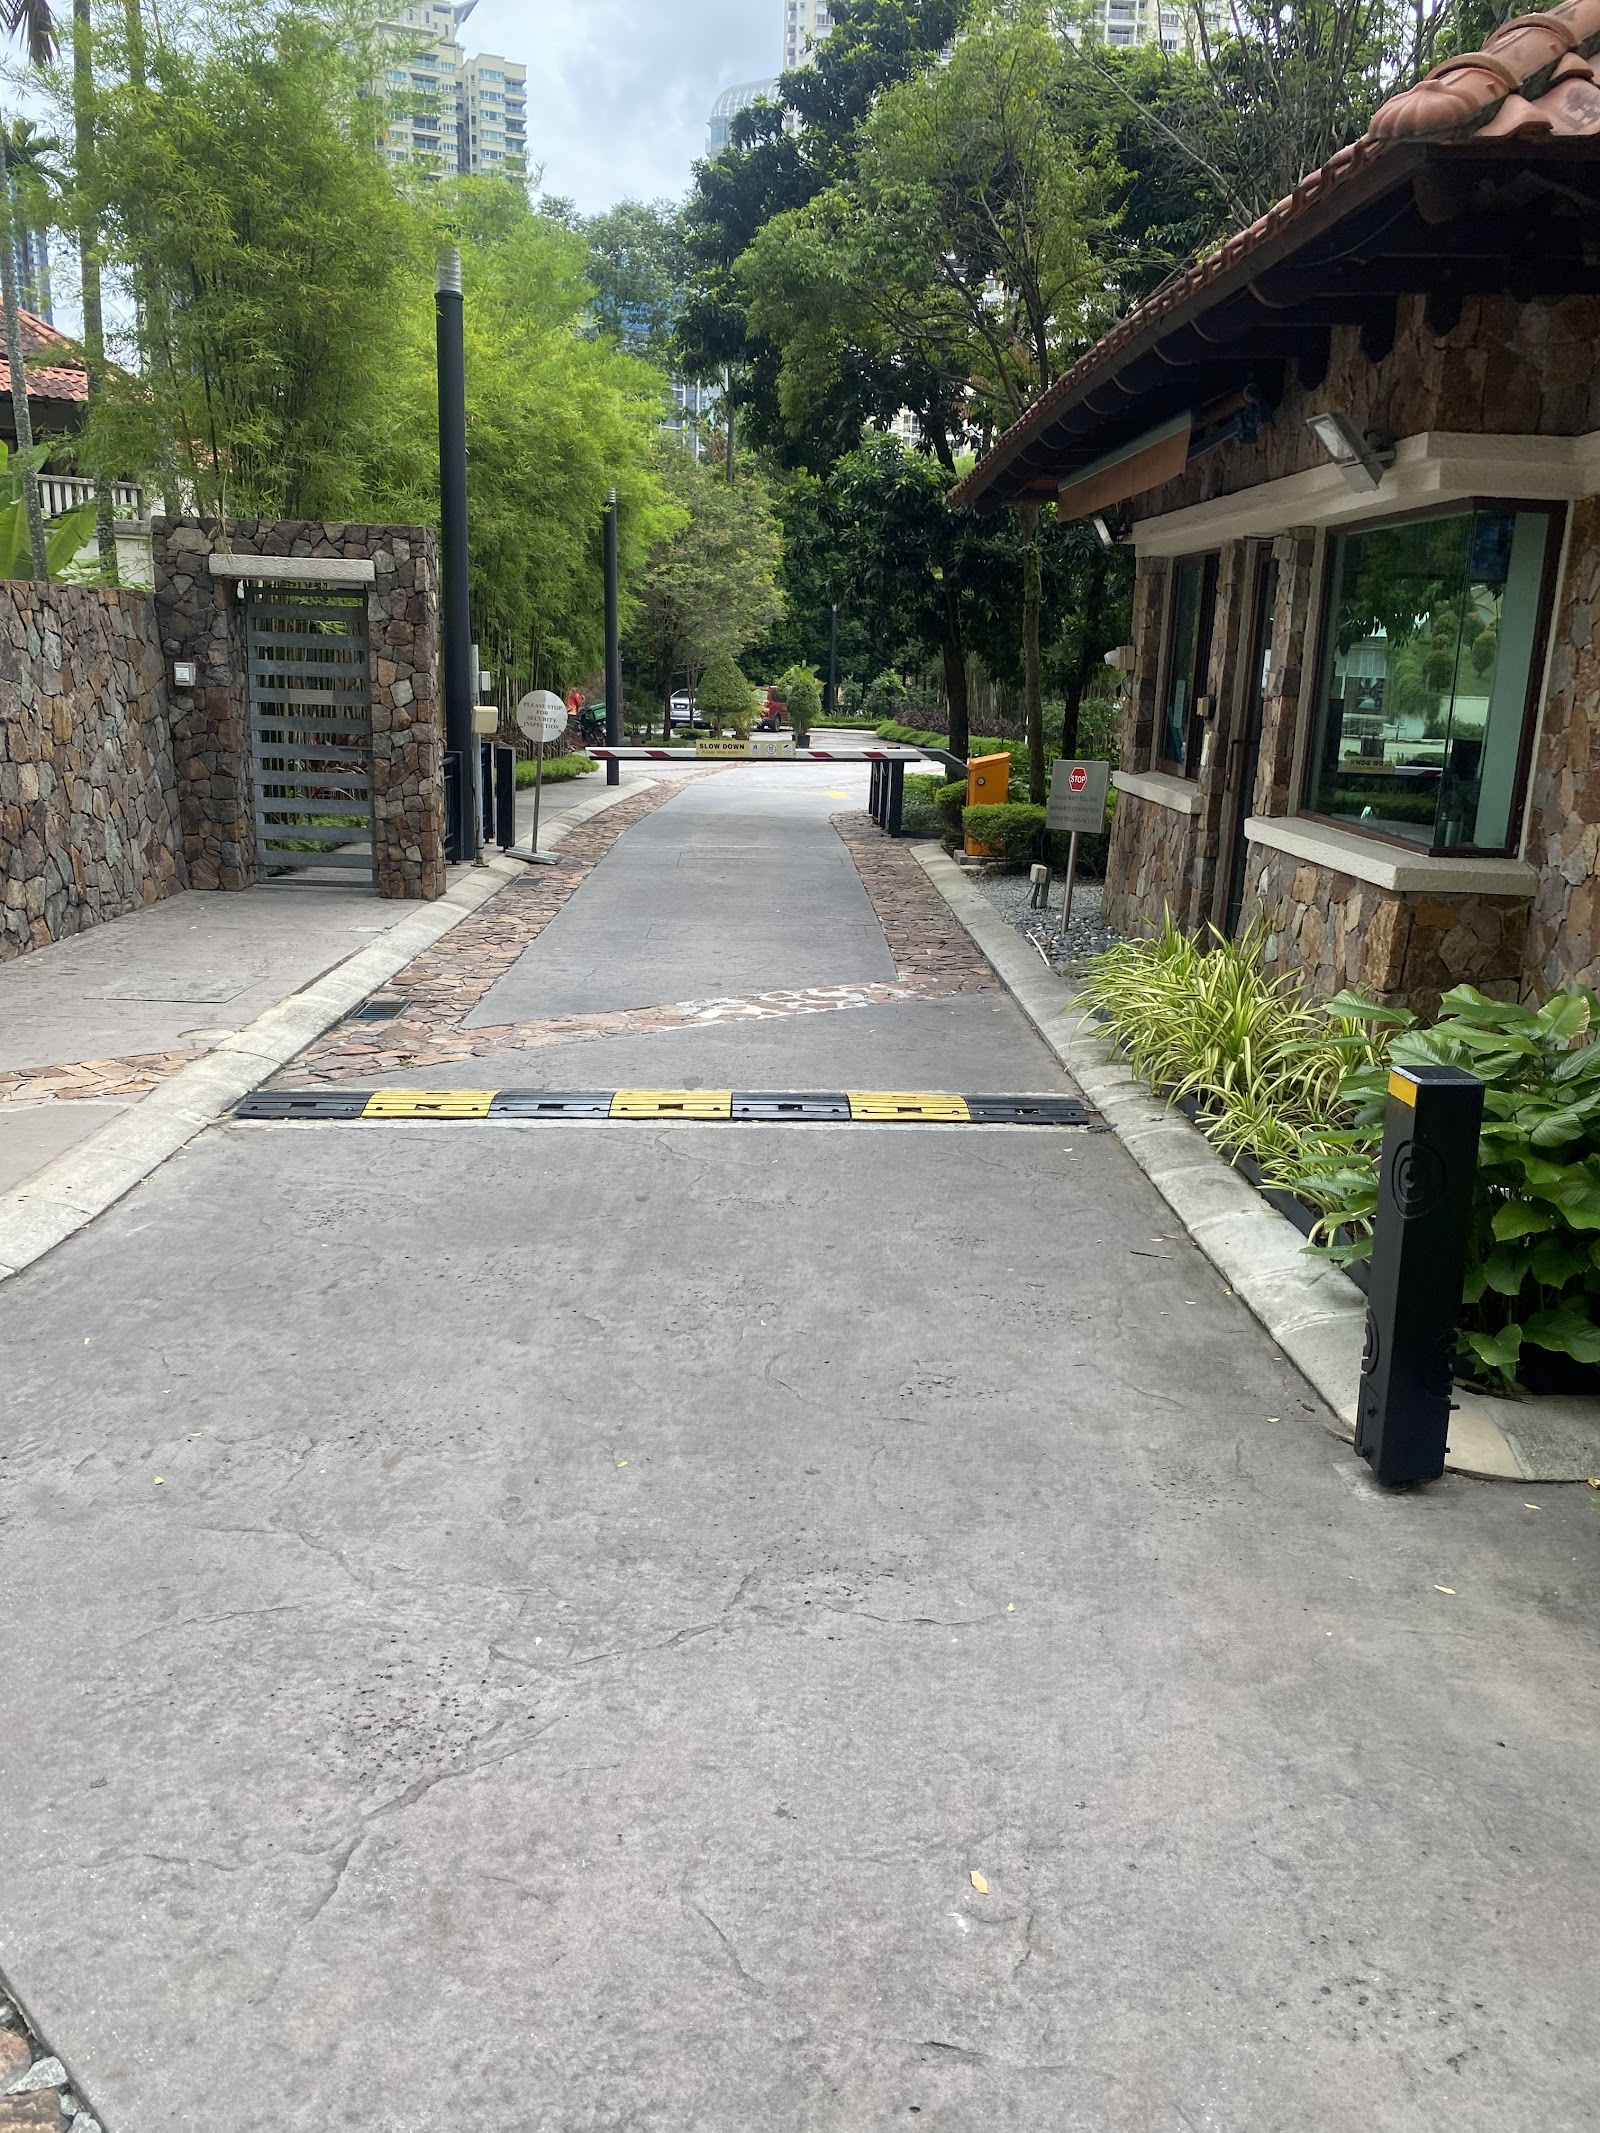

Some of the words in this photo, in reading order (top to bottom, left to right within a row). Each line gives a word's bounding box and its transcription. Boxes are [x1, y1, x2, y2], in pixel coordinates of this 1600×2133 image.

[527, 715, 556, 723] SECURITY
[523, 721, 560, 729] INSPECTION
[1070, 775, 1086, 784] STOP
